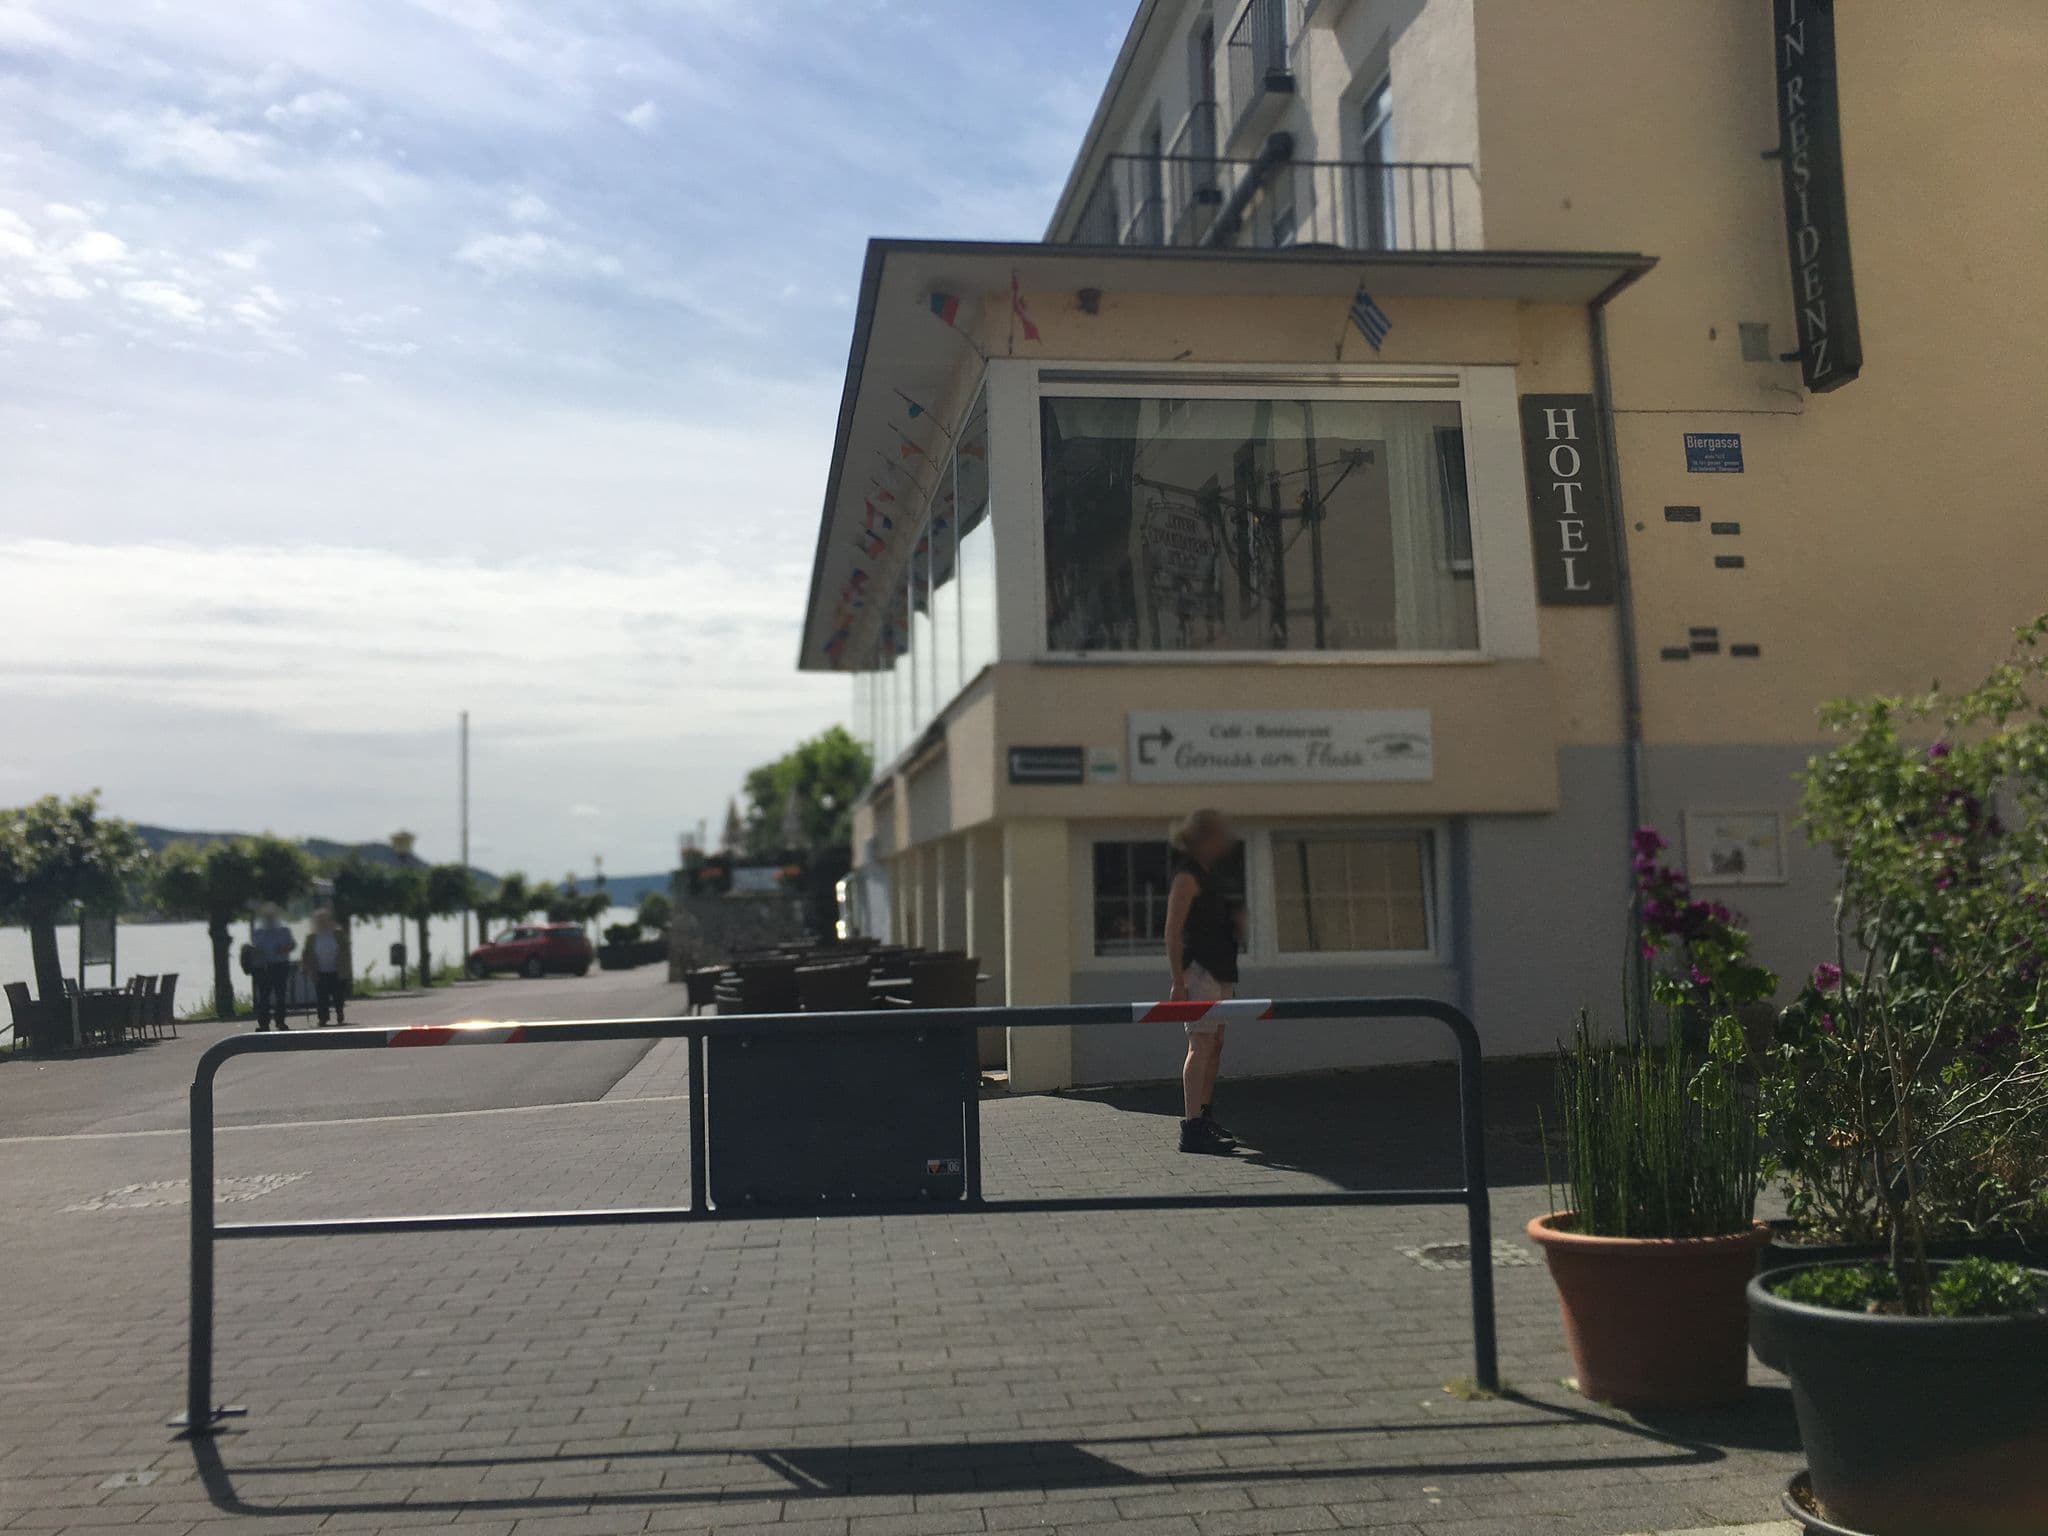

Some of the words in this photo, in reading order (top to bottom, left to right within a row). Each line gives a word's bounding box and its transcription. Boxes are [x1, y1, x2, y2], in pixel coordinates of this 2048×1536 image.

[1786, 75, 1832, 379] RESIDENZ
[1543, 408, 1591, 591] HOTEL
[1687, 436, 1739, 451] Biergasse
